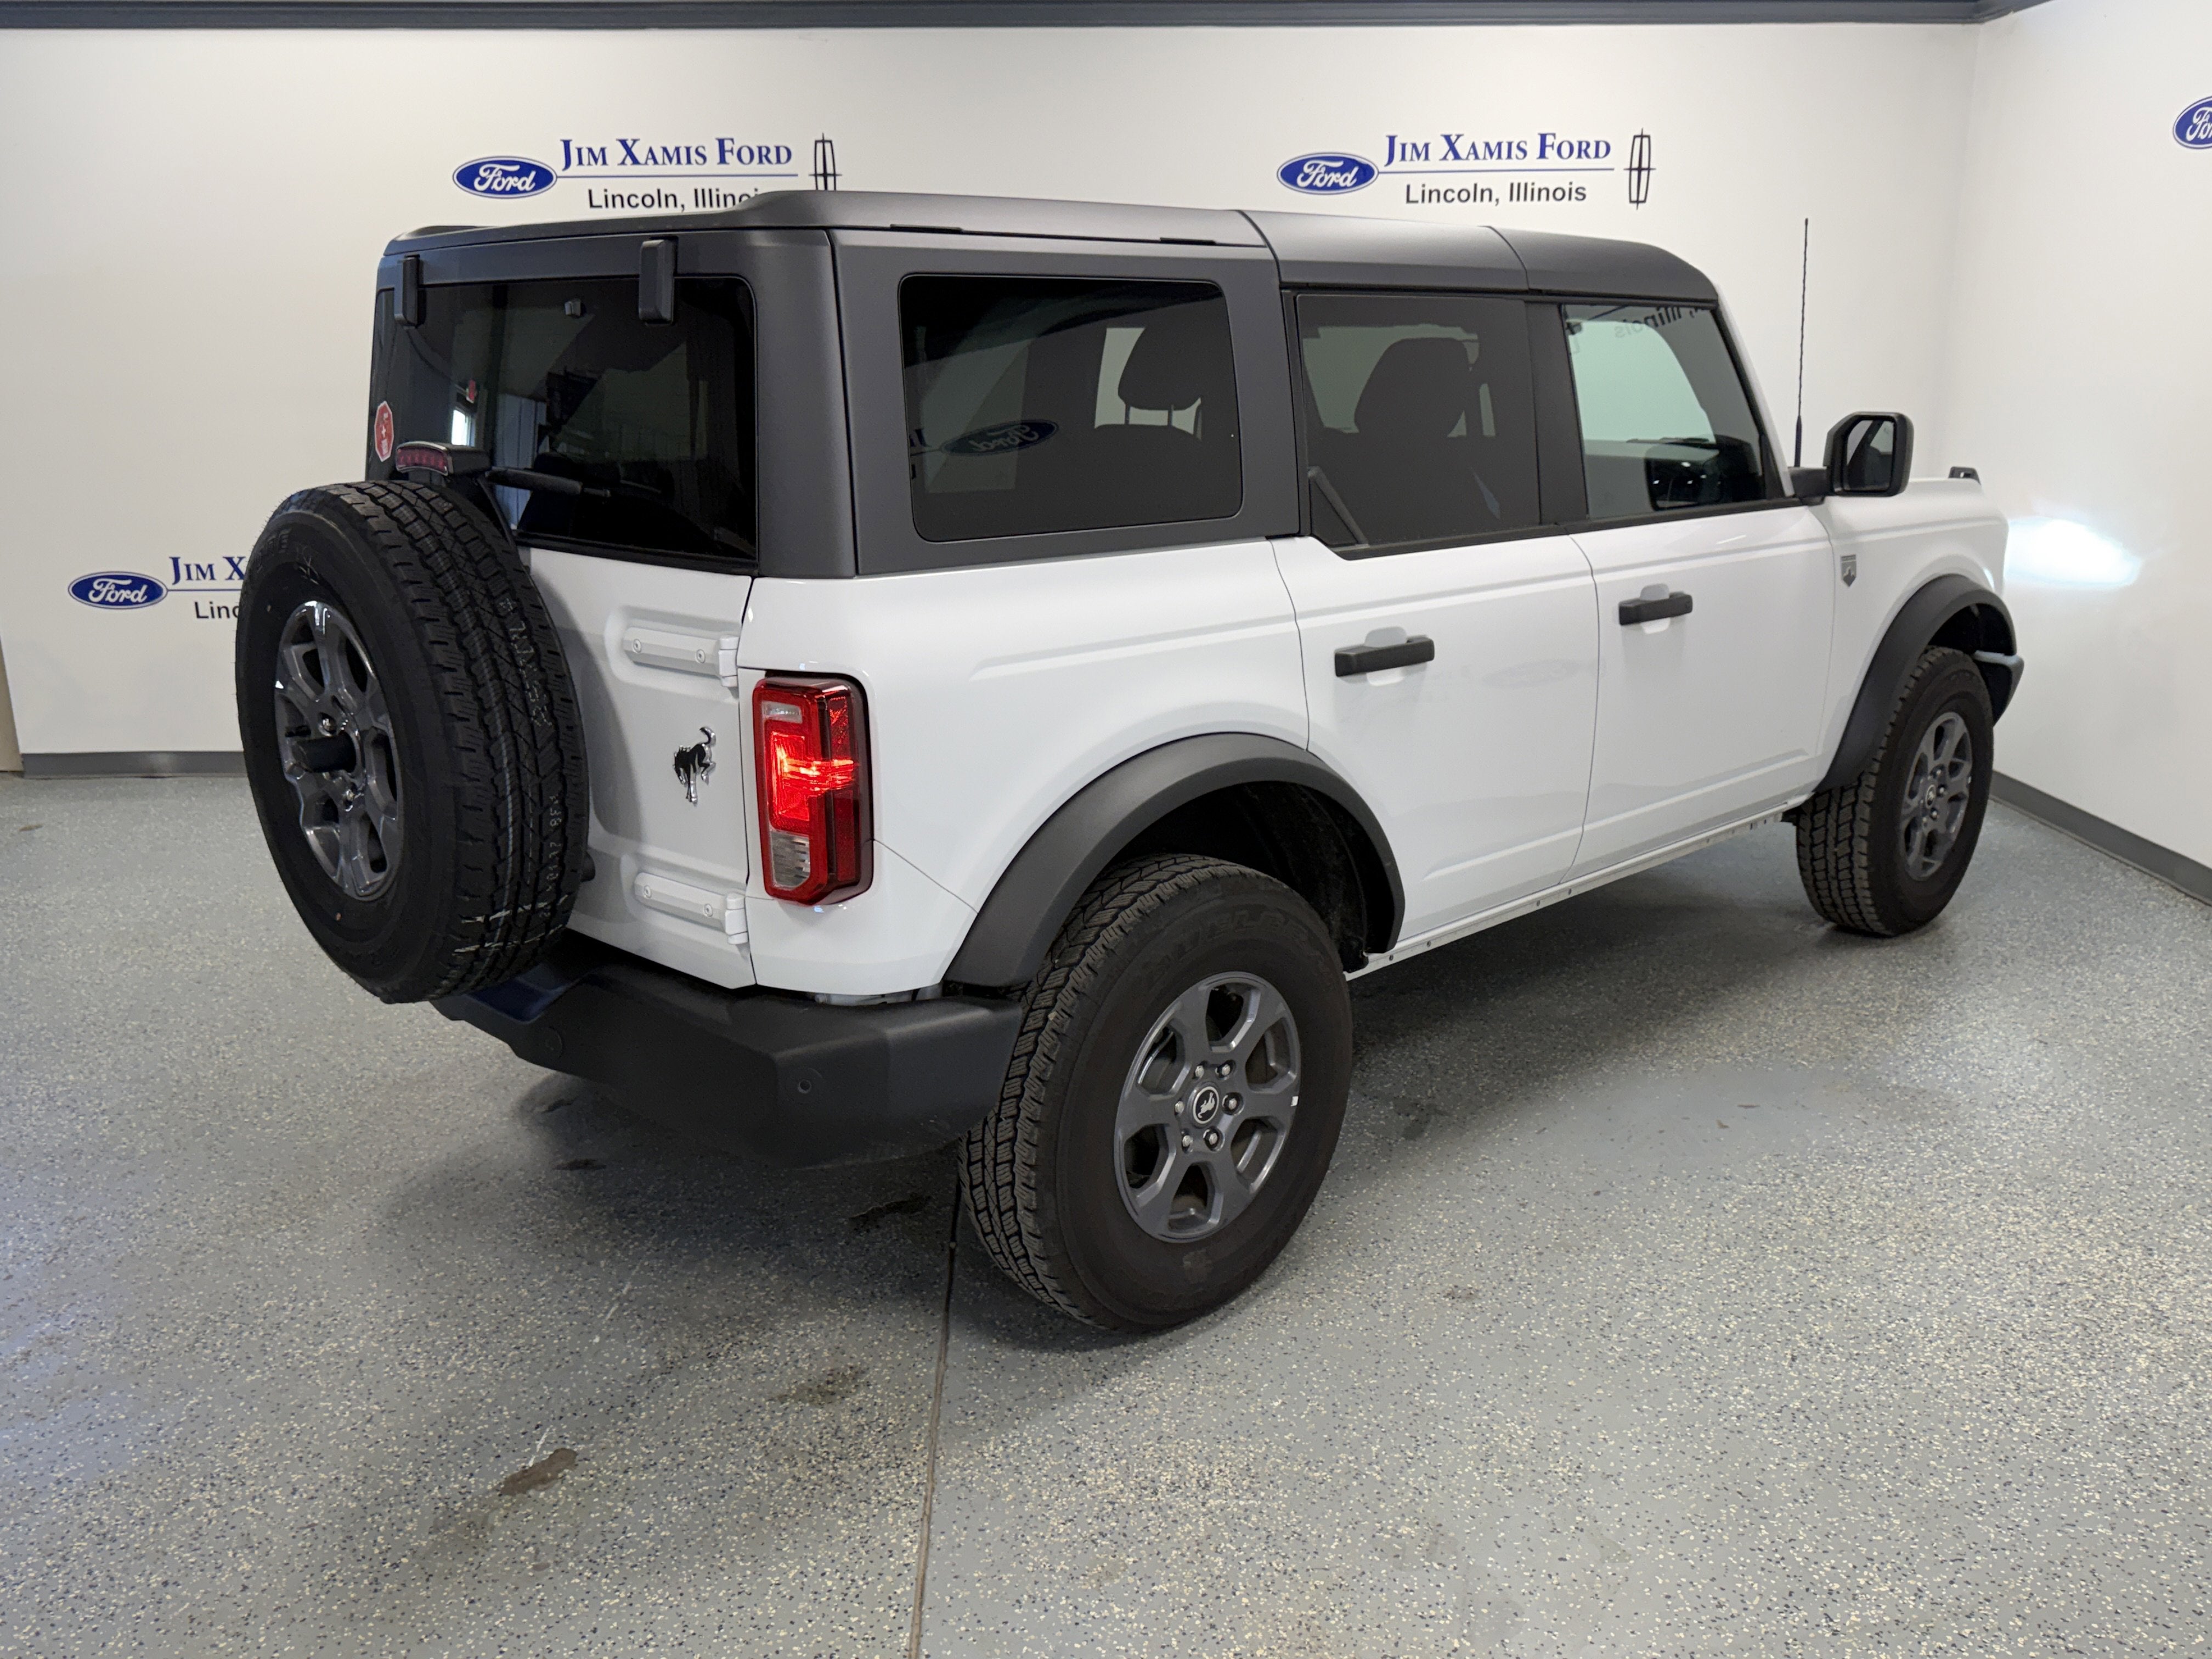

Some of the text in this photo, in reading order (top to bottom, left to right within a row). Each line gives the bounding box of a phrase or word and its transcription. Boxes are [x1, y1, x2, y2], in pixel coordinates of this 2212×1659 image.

[2186, 106, 2212, 142] Fo
[560, 138, 793, 171] JIM XAMIS FORD
[1384, 133, 1611, 167] JIM XAMIS FORD
[472, 165, 536, 192] Ford
[1296, 160, 1358, 189] Ford
[588, 188, 685, 212] Lincoln,
[1406, 182, 1587, 205] Lincoln, Illinois
[169, 556, 217, 585] JIM
[88, 578, 148, 603] Ford
[194, 601, 239, 619] Linc
